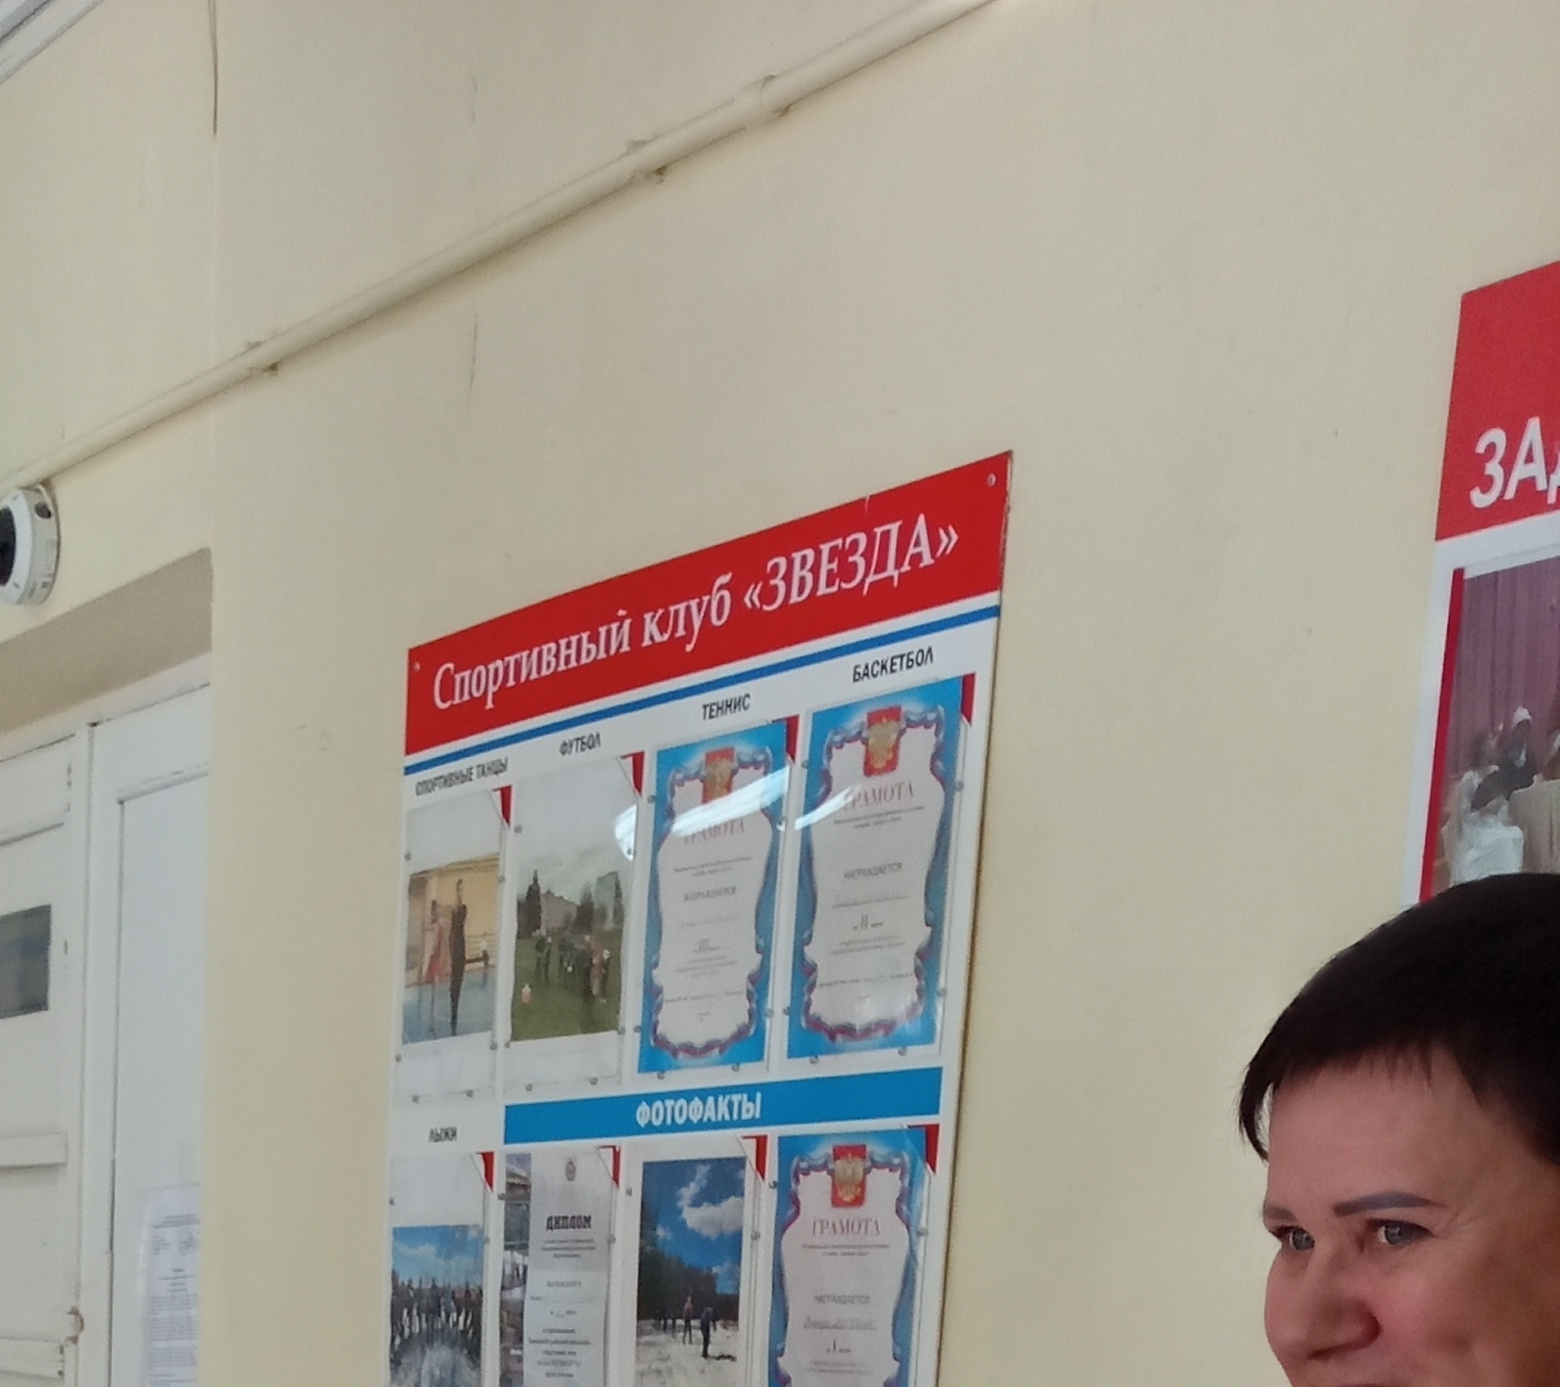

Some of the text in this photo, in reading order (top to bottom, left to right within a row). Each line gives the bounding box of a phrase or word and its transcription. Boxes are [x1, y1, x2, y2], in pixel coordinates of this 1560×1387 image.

[1470, 416, 1560, 509] ЗА
[434, 513, 959, 711] Спортивный клуб «ЗВЕЗДА»
[852, 646, 934, 683] БАСКЕТБОЛ
[702, 693, 751, 721] ТЕННИС
[559, 732, 601, 757] ФУТБОЛ
[636, 1092, 762, 1128] ФОТОФАКТЫ
[811, 1217, 881, 1237] ГРАМОТА
